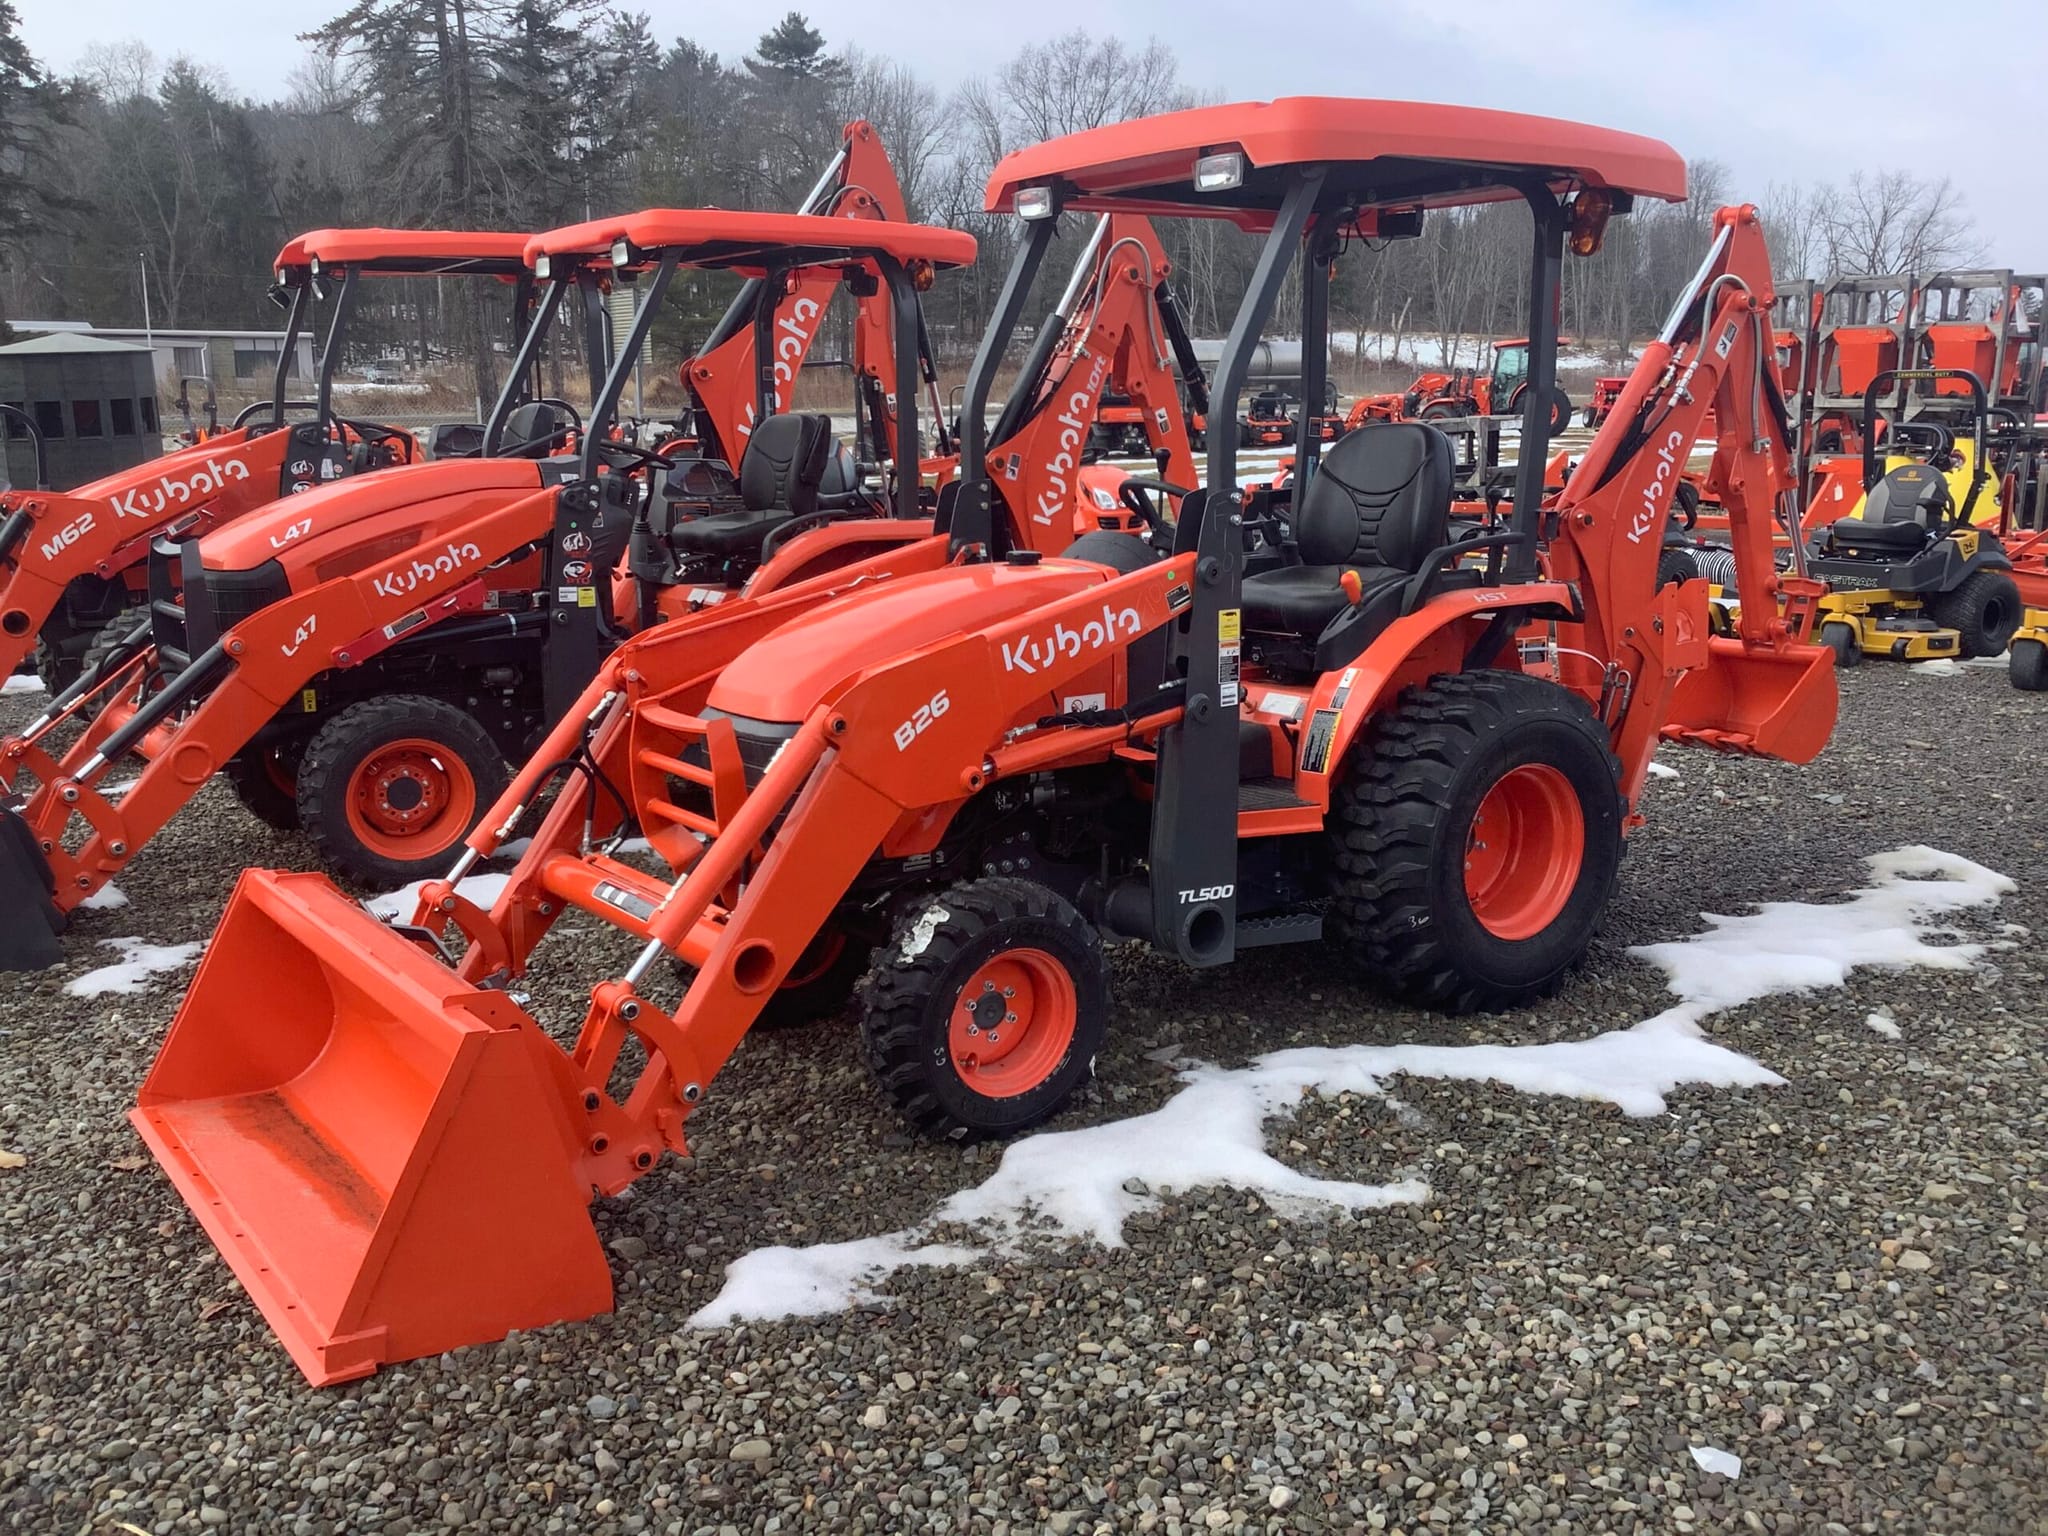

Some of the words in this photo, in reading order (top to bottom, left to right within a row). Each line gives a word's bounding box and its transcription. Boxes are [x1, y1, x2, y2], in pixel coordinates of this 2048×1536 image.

[1033, 391, 1090, 526] Kubota
[110, 458, 250, 519] Kubota
[1627, 430, 1684, 545] Kubota
[41, 512, 96, 561] M62
[270, 518, 312, 549] L47
[374, 543, 481, 597] Kubota
[281, 614, 317, 657] L47
[1002, 604, 1141, 674] Kubota
[893, 689, 951, 752] B26
[1179, 884, 1234, 905] TL500
